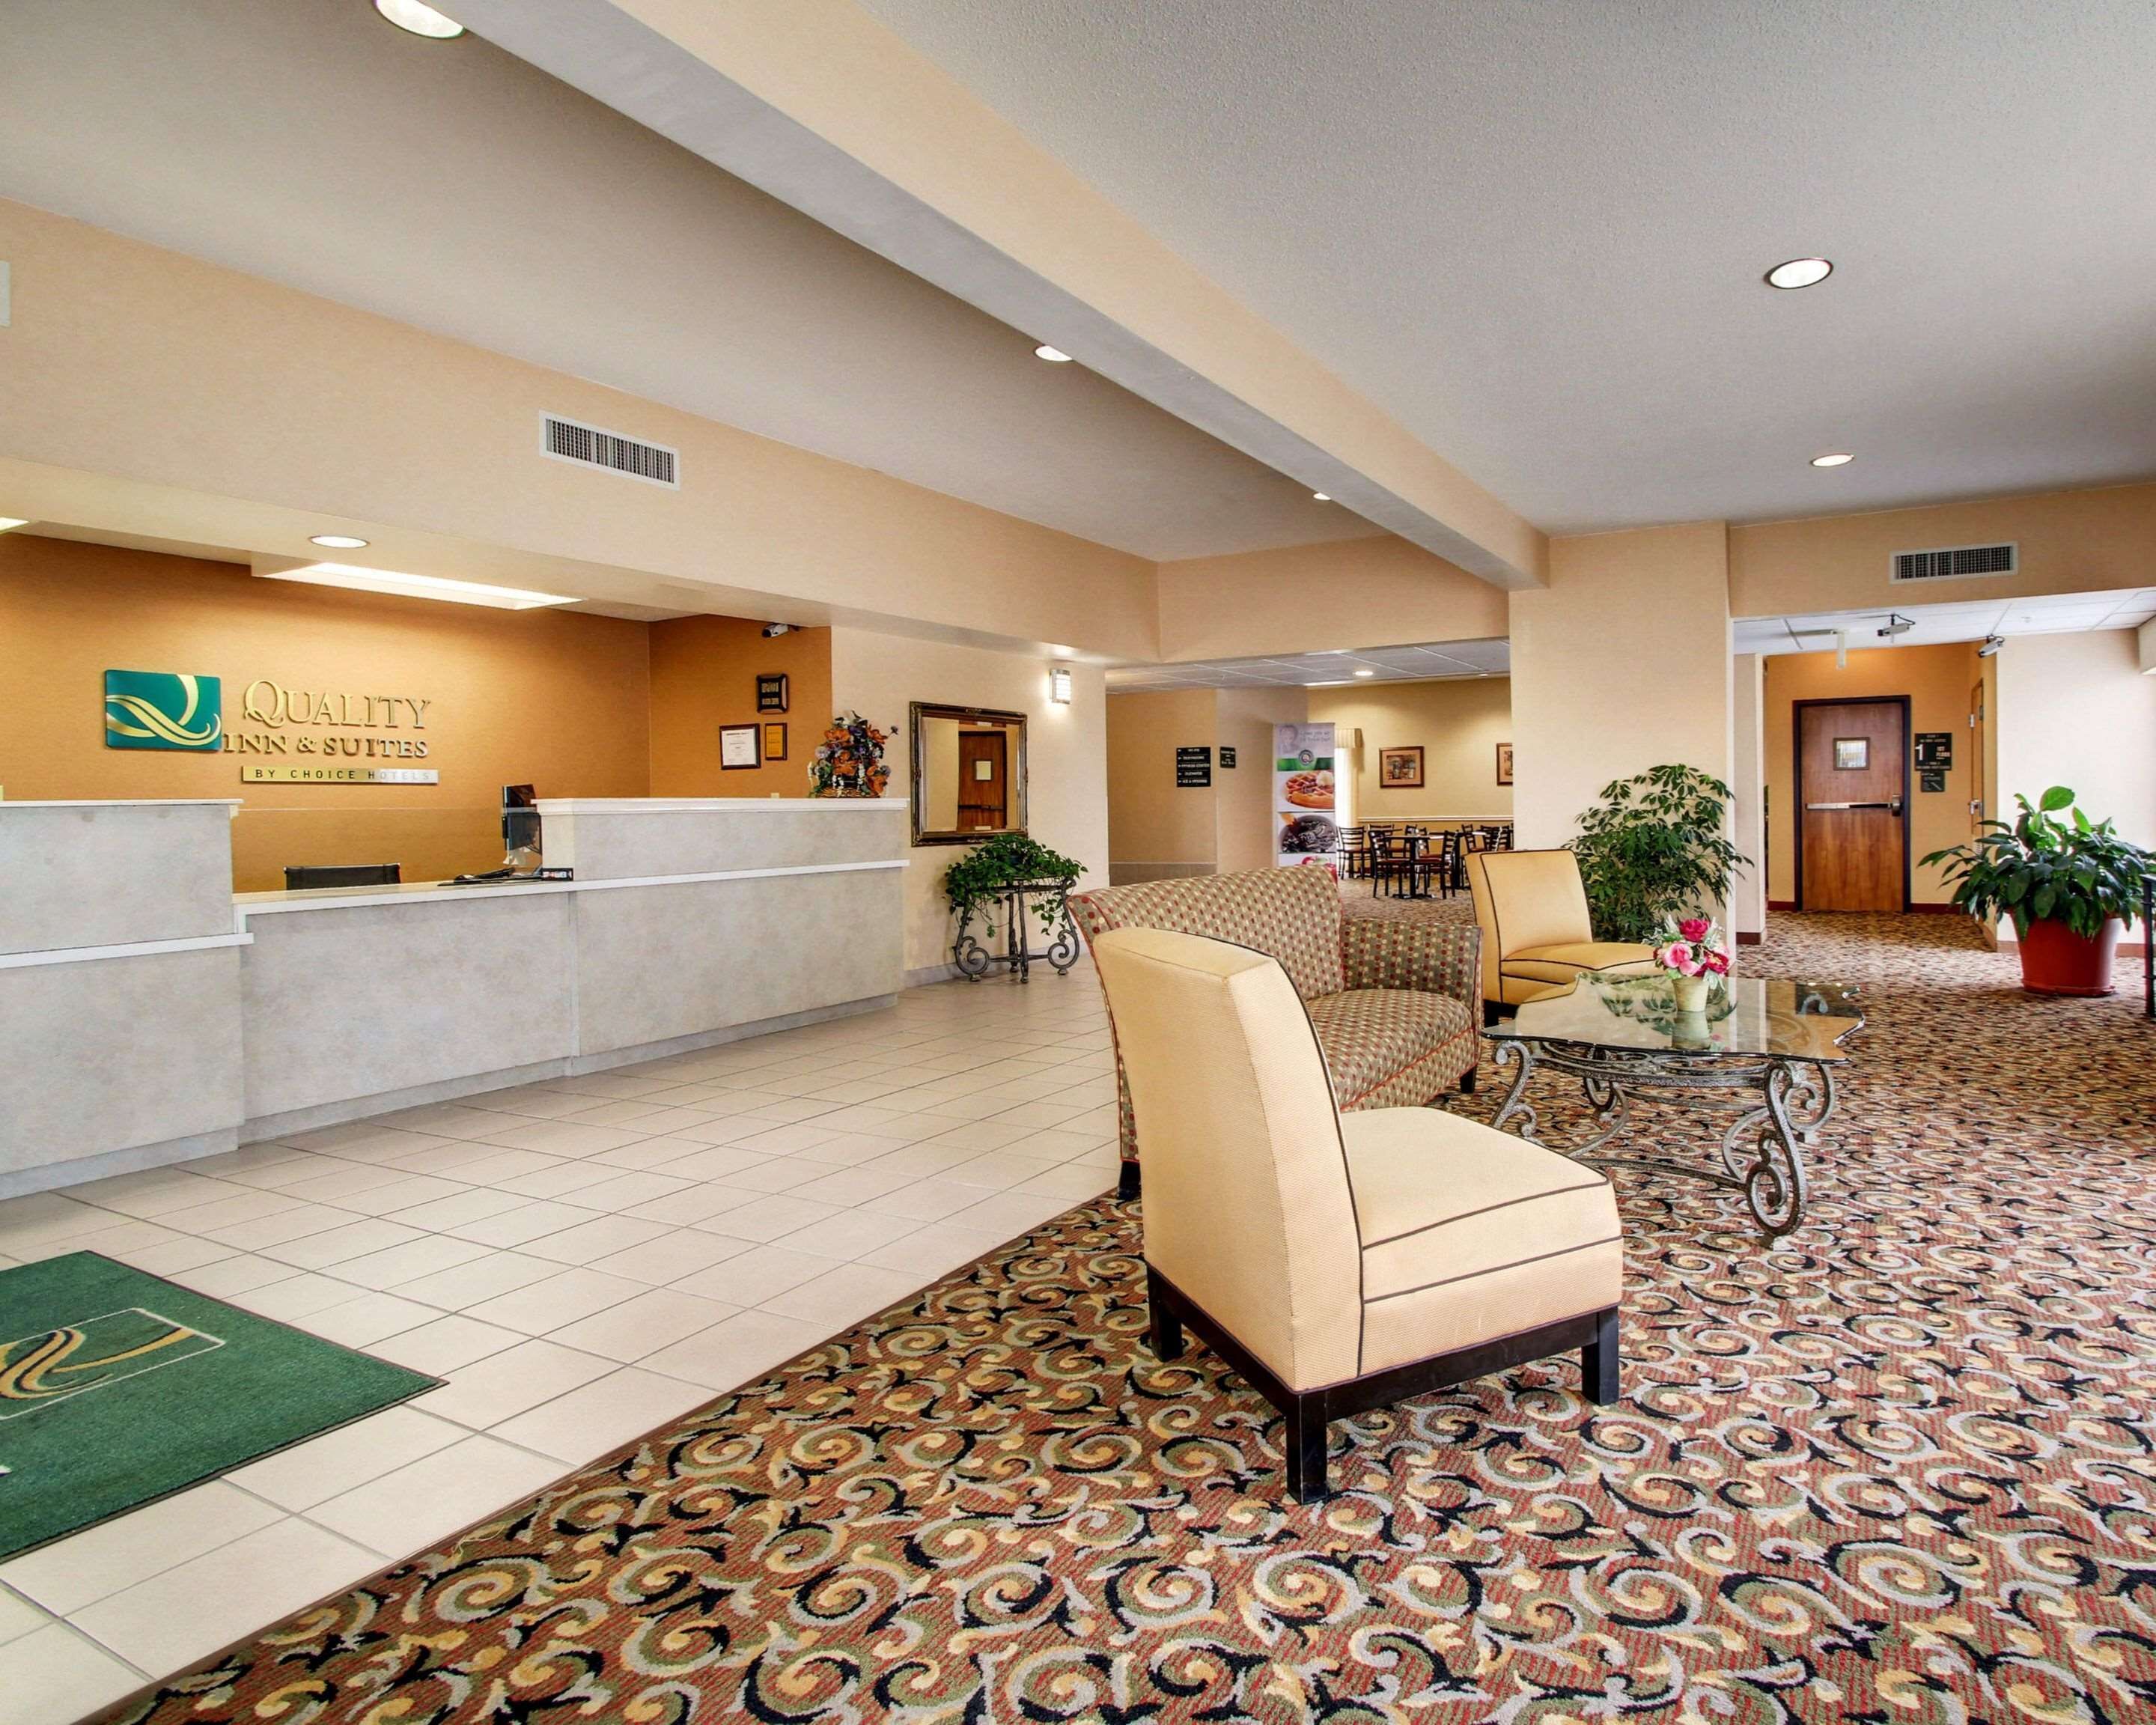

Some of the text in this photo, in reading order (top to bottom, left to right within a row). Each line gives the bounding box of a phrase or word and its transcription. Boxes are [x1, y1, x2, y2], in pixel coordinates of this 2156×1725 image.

[243, 679, 431, 729] QUALITY
[223, 733, 429, 759] INN & SUITES
[1915, 743, 1923, 761] 1
[255, 769, 430, 780] BY CHOICE HOTELS
